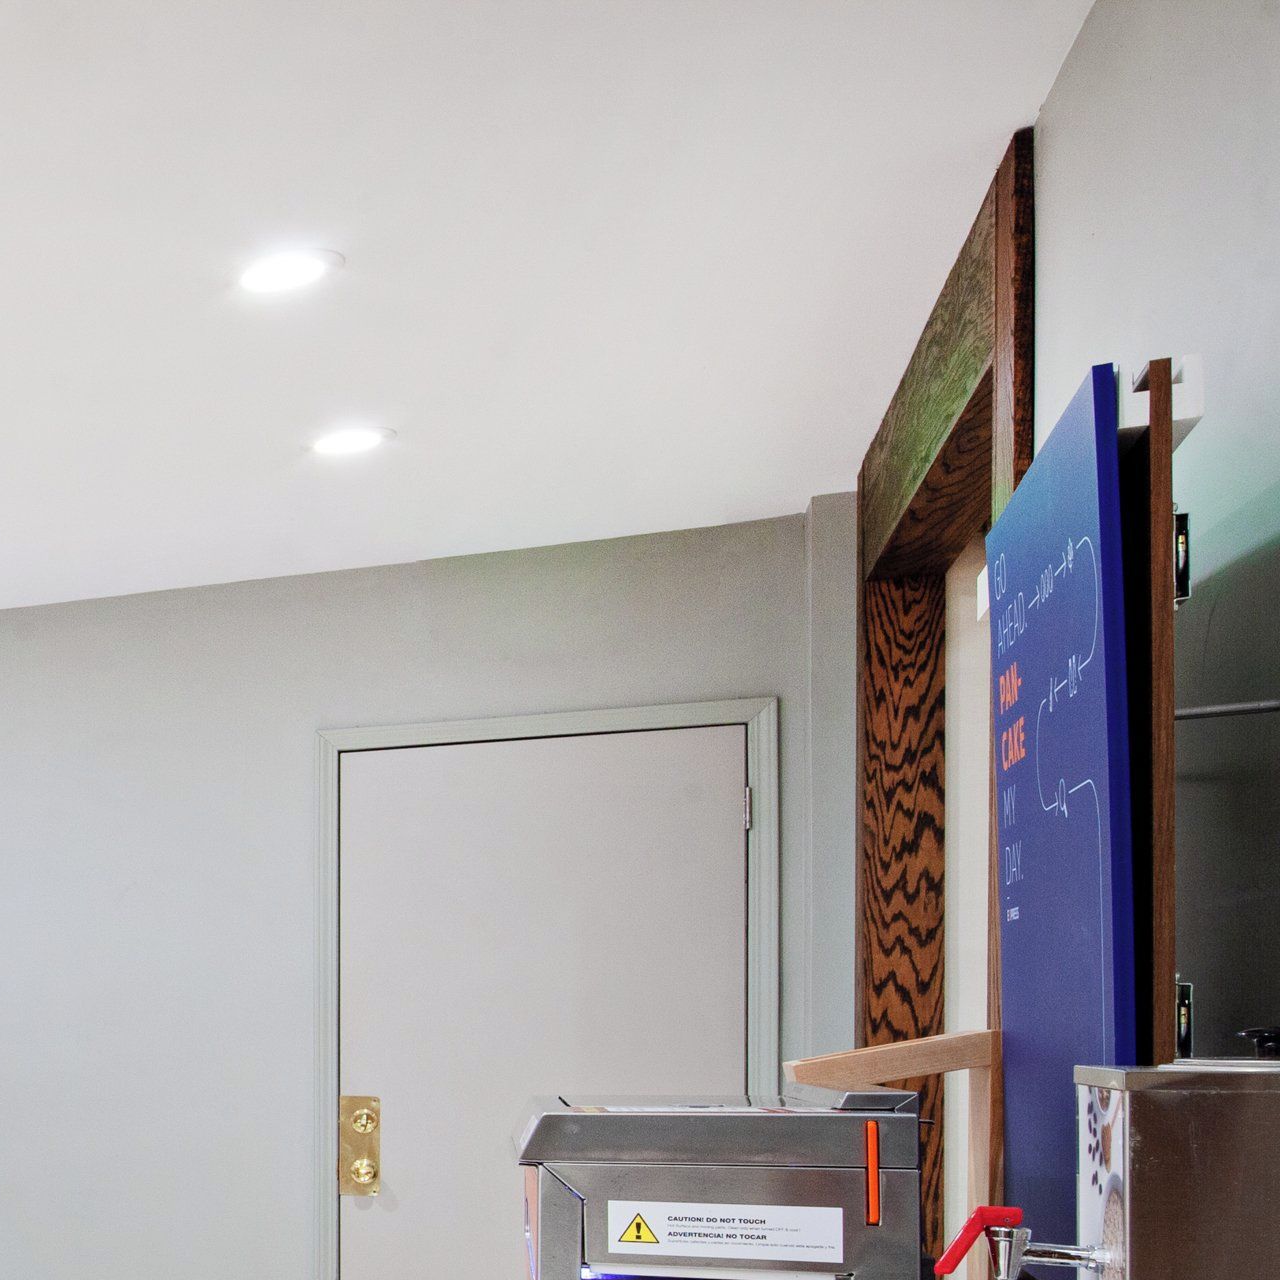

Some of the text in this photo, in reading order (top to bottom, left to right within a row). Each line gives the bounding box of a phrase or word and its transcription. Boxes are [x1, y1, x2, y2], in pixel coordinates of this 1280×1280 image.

[994, 552, 1007, 601] GO
[997, 591, 1028, 660] AHEAD.
[999, 661, 1022, 715] PAN-
[1001, 716, 1026, 772] CAKE
[667, 1215, 704, 1223] CAUTION!
[667, 1231, 724, 1239] ADVERTENCIA!
